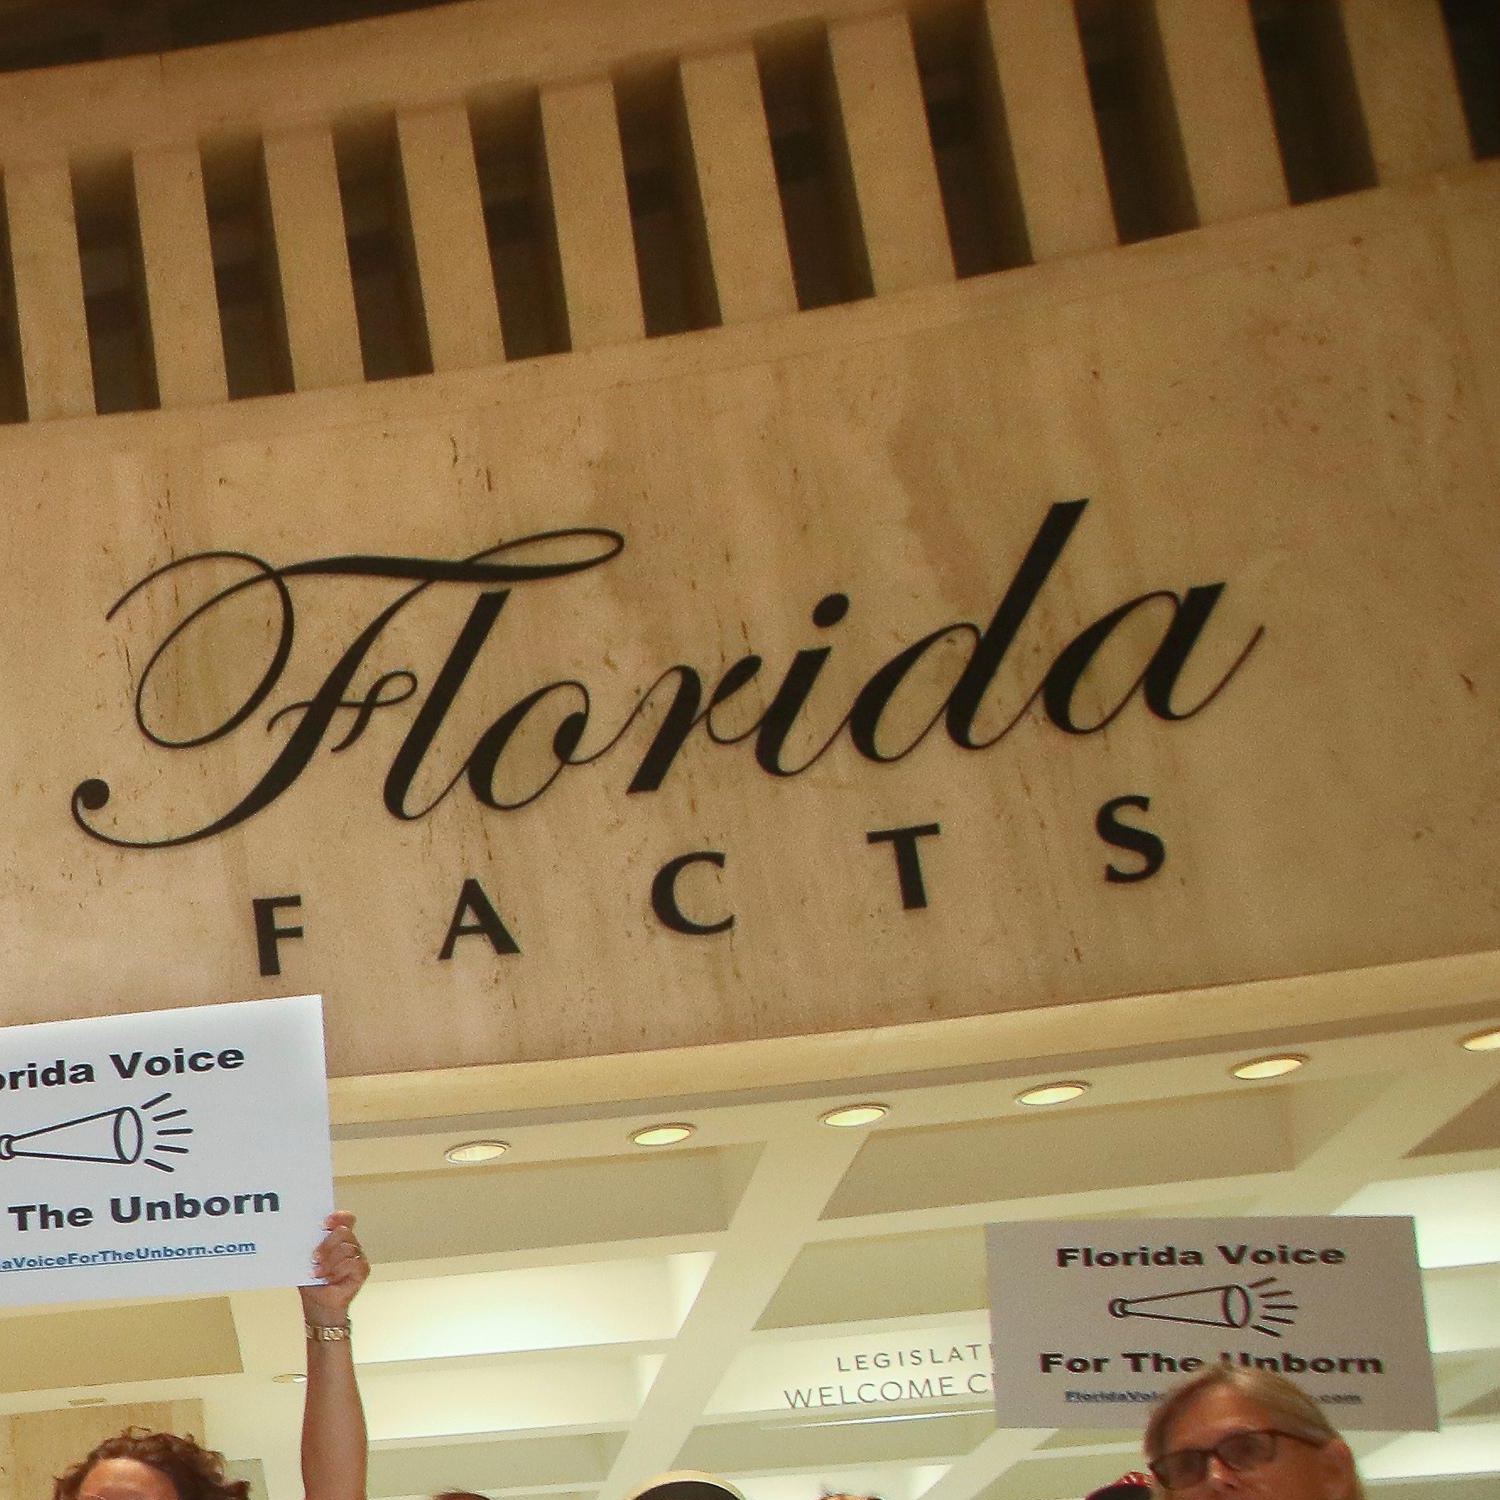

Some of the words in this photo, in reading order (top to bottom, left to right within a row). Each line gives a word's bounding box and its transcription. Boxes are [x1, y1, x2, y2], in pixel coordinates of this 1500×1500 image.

[71, 497, 1264, 849] Florida
[252, 795, 1166, 976] FACTS
[109, 1047, 246, 1080] Voice
[8, 1202, 94, 1233] The
[110, 1189, 281, 1225] Unborn
[1055, 1243, 1204, 1270] Florida
[1218, 1243, 1346, 1267] Voice
[1039, 1352, 1111, 1373] For
[1121, 1352, 1203, 1373] The
[784, 1375, 959, 1409] WELCOME
